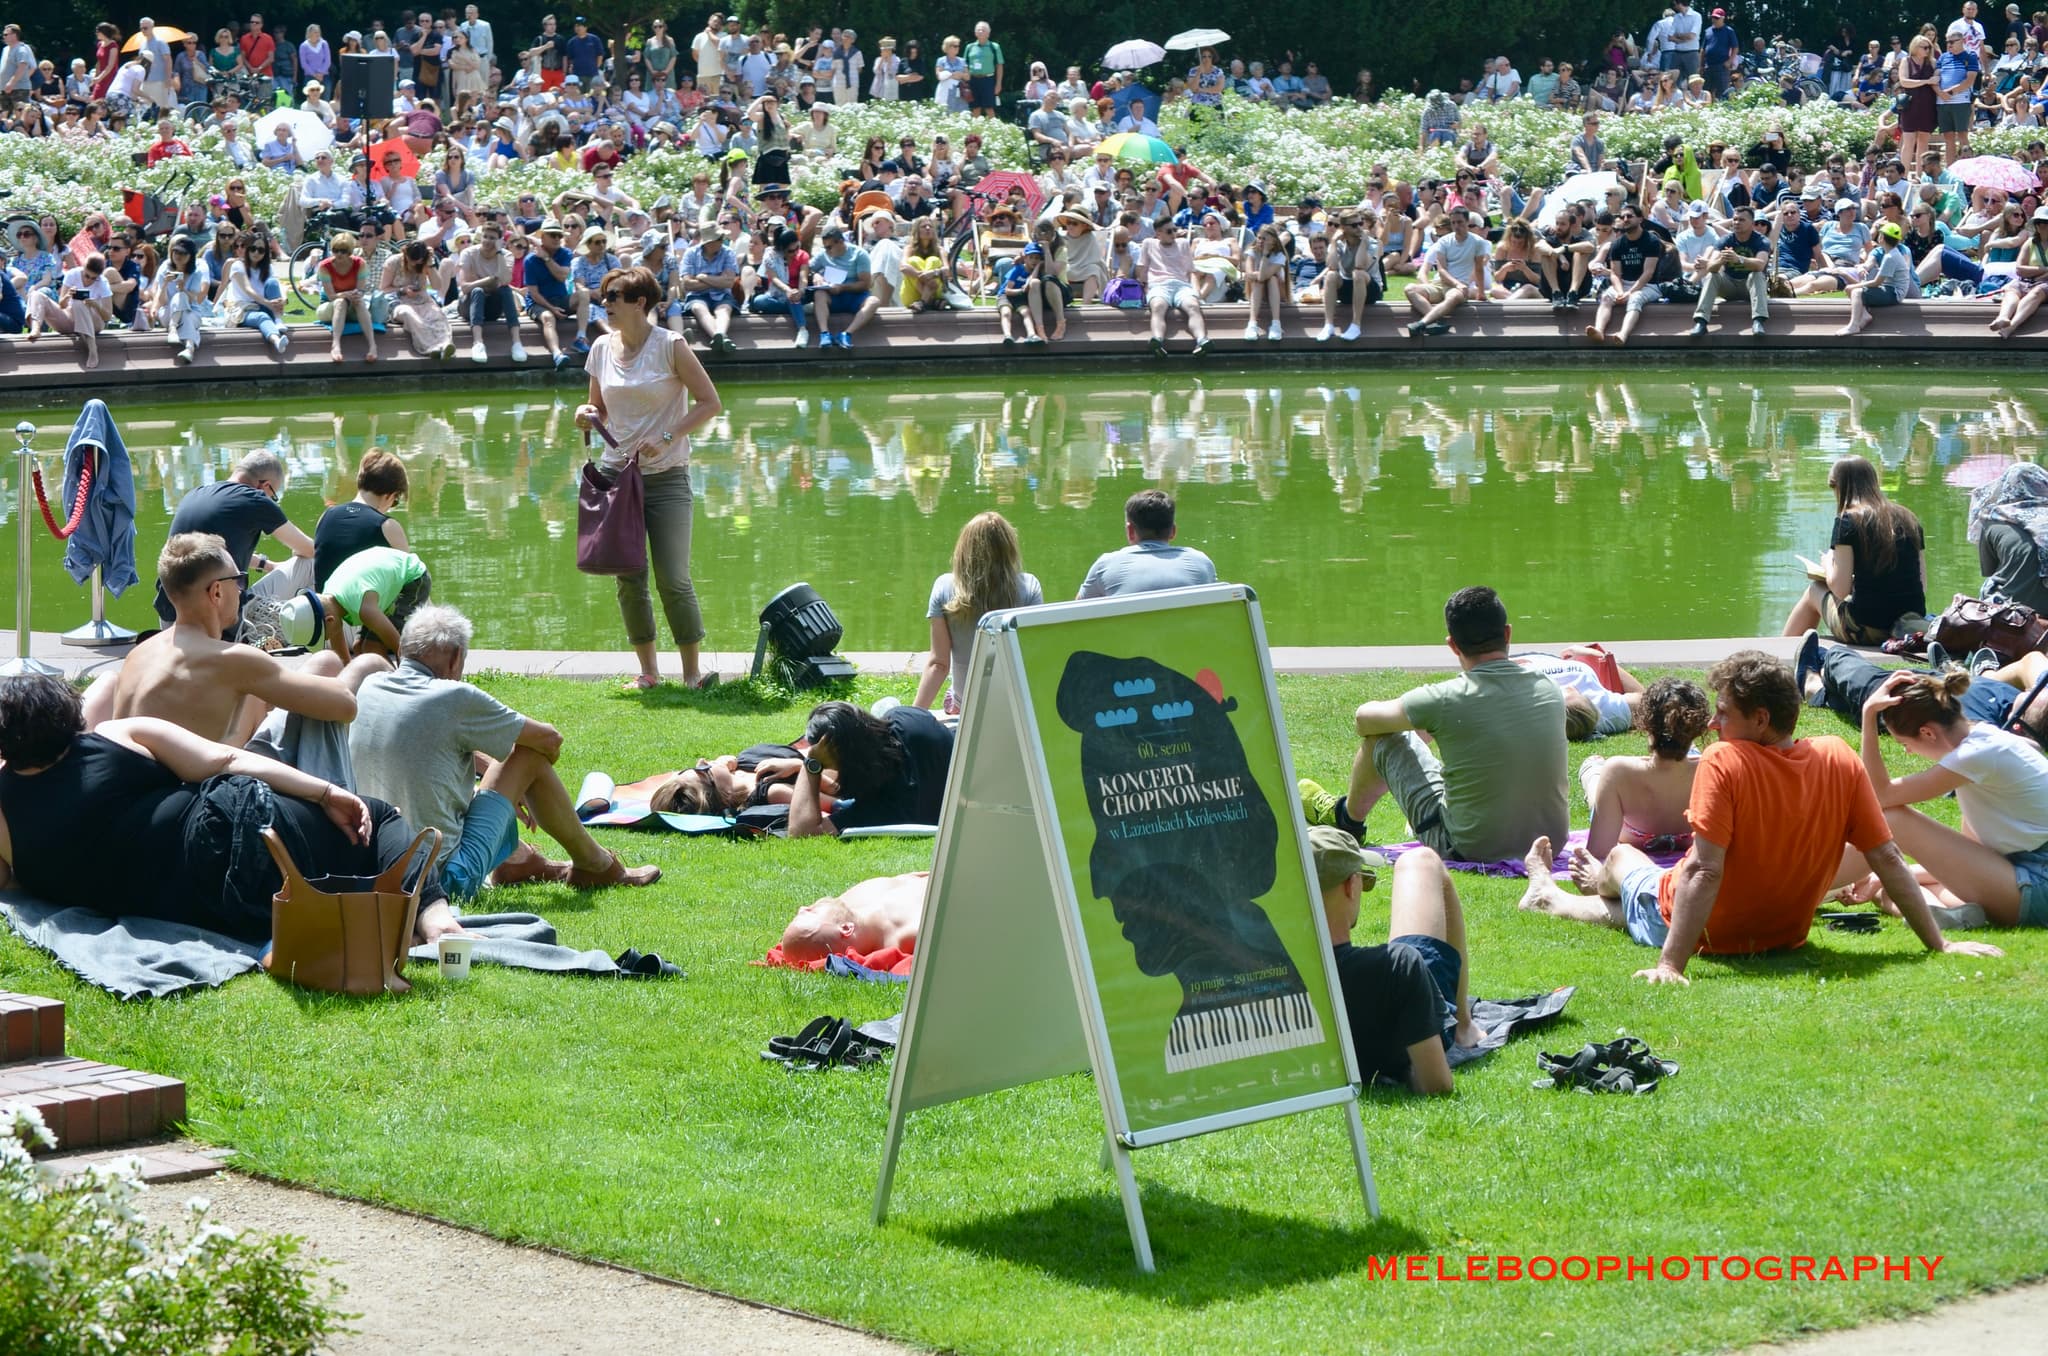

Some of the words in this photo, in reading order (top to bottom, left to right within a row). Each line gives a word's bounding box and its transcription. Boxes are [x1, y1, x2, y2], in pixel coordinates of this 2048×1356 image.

[1138, 743, 1158, 759] 60.
[1160, 741, 1192, 757] sezon
[1098, 763, 1196, 797] KONCERTY
[1102, 777, 1244, 817] CHOPINOWSKIE
[1109, 829, 1121, 840] w
[1185, 801, 1248, 829] Królewskich
[1201, 976, 1225, 992] maja
[1233, 974, 1246, 987] 29
